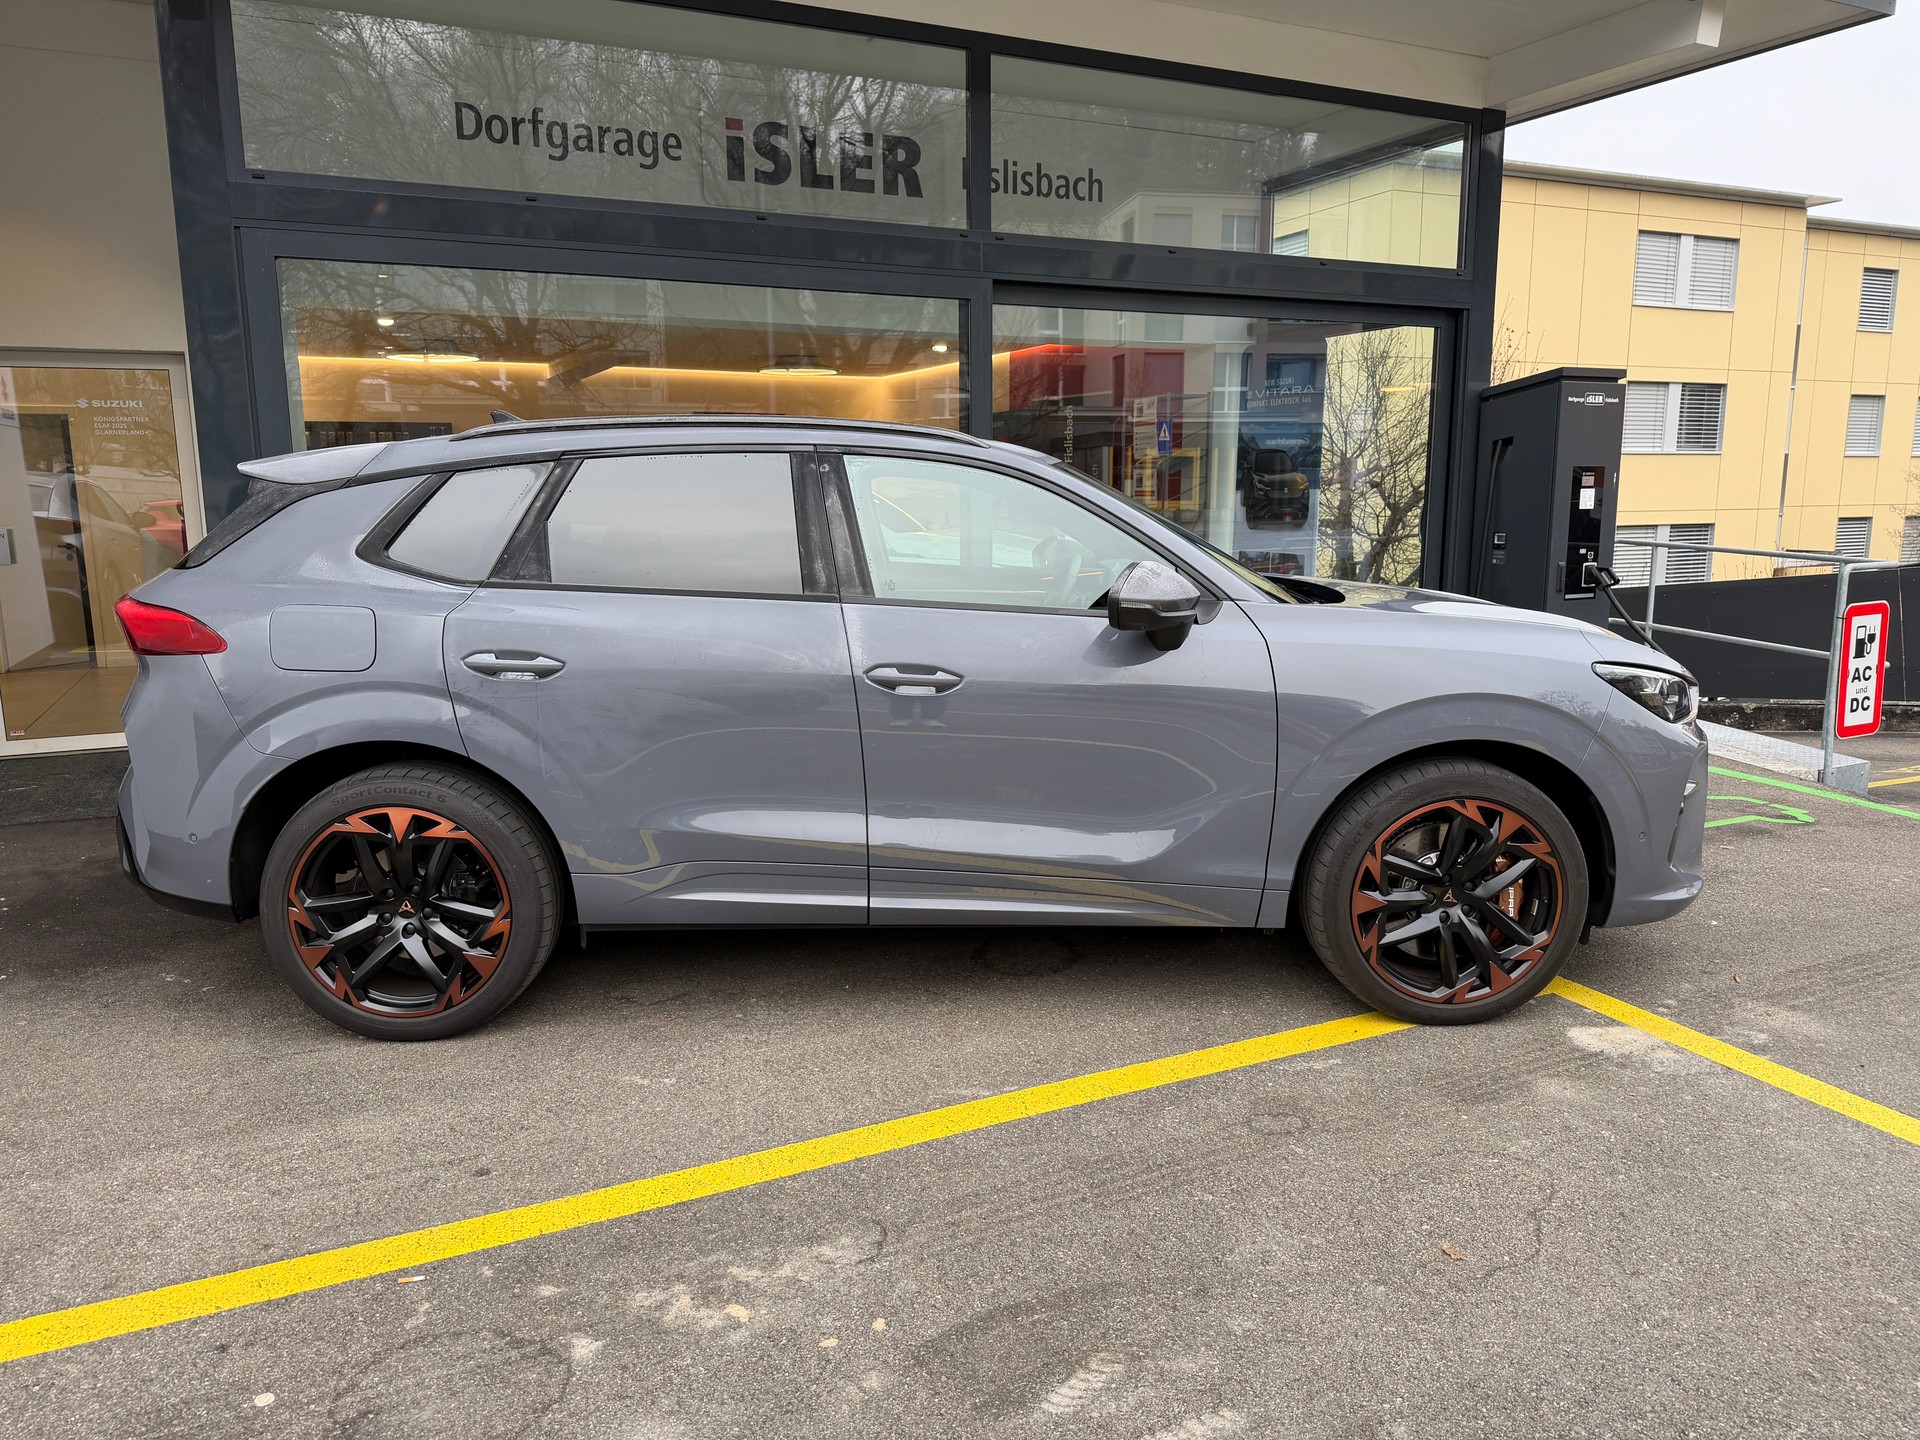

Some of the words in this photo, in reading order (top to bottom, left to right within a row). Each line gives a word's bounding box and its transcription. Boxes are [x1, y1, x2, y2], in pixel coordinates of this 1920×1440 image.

[454, 101, 683, 170] Dorfgarage
[725, 117, 924, 199] iSLER
[962, 156, 1104, 203] slisbach
[1255, 385, 1315, 398] VITARA
[91, 399, 144, 408] SUZUKI
[1063, 405, 1074, 463] Fislisbach
[1851, 665, 1873, 684] AC
[1855, 685, 1868, 695] und
[1850, 695, 1871, 714] DC
[331, 786, 433, 806] SportContact
[437, 794, 448, 804] 6
